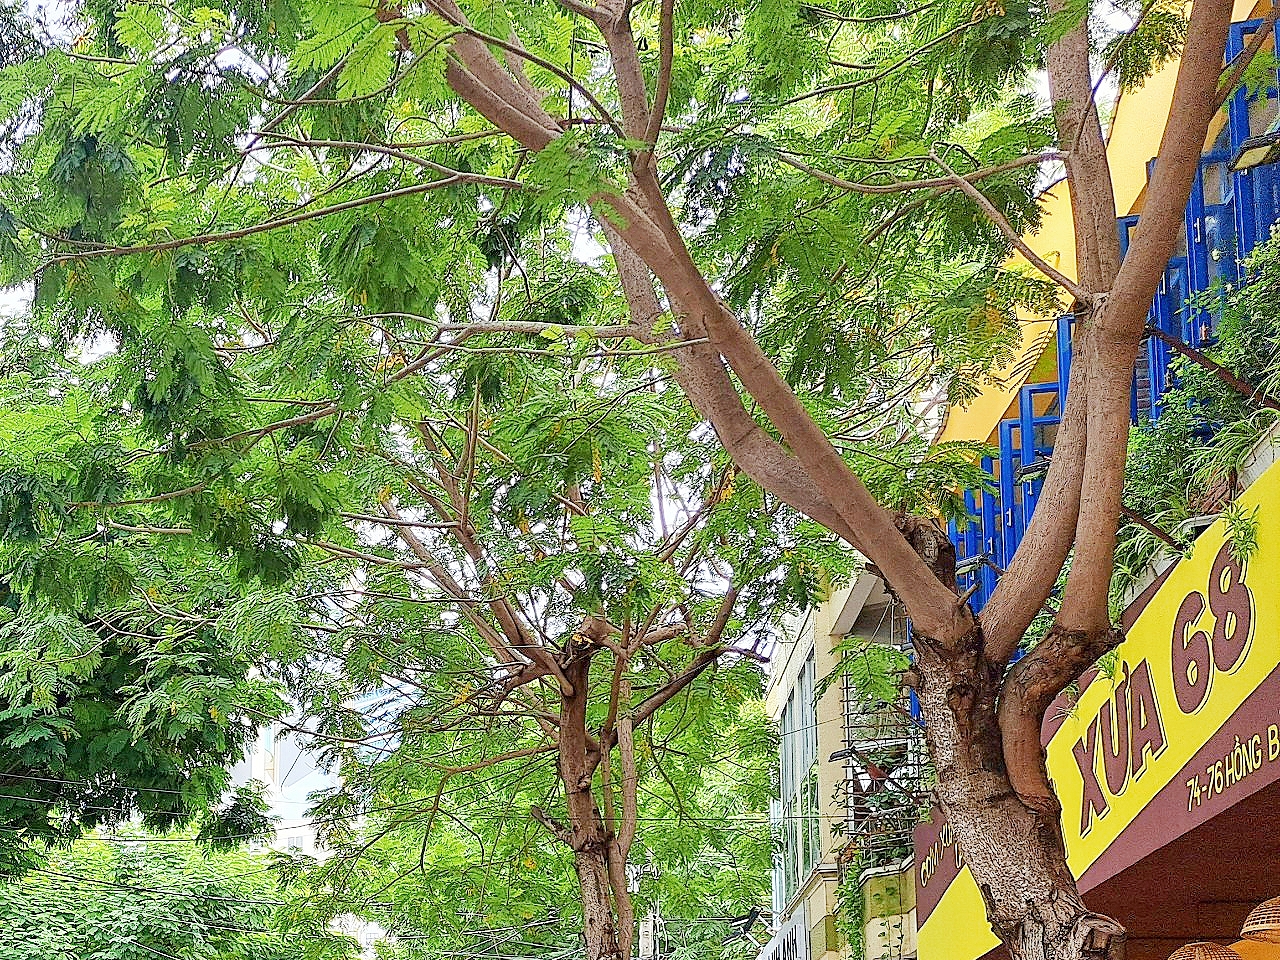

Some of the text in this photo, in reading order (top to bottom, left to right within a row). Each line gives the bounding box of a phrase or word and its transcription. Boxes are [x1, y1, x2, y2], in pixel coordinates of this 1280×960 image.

[1171, 538, 1255, 716] 68
[1186, 760, 1223, 812] 74-76
[1224, 733, 1262, 788] HỒNG
